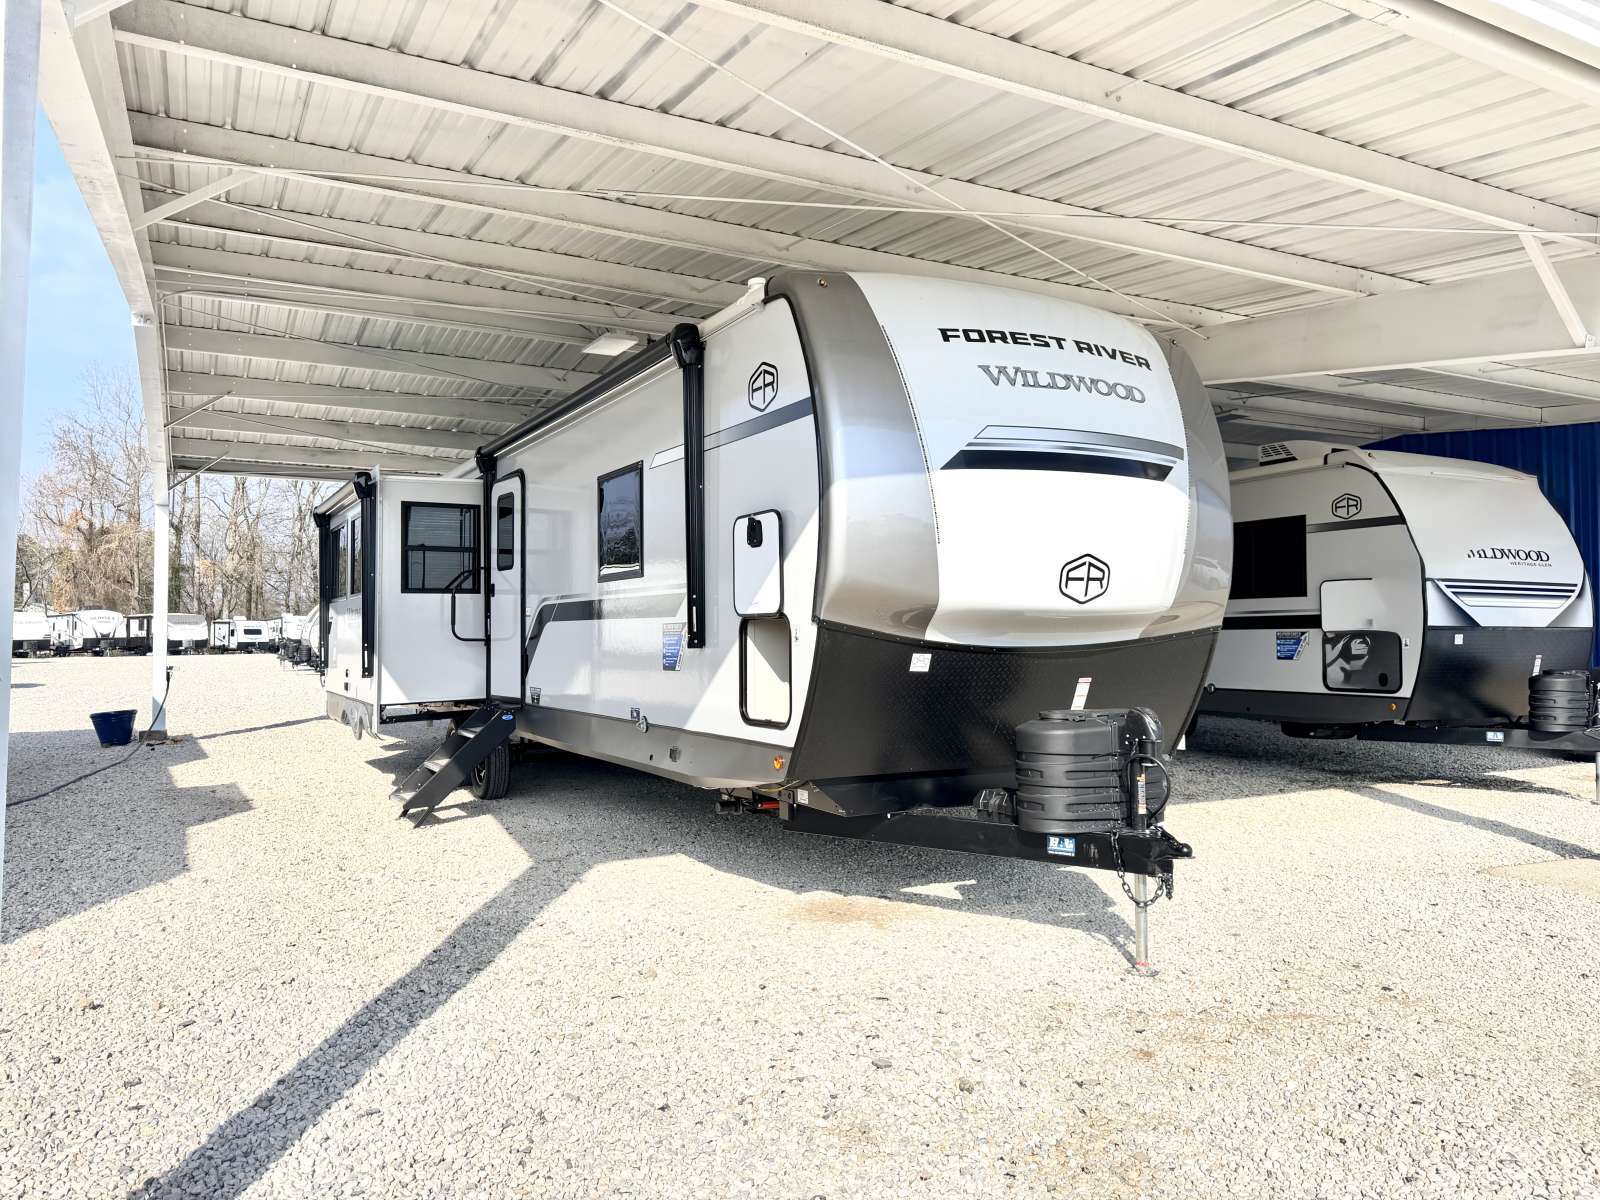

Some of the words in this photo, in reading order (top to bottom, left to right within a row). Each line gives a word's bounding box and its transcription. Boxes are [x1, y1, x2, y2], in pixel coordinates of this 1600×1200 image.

[937, 327, 1066, 350] FOREST
[1072, 339, 1152, 371] RIVER
[977, 364, 1146, 404] WILDWOOD
